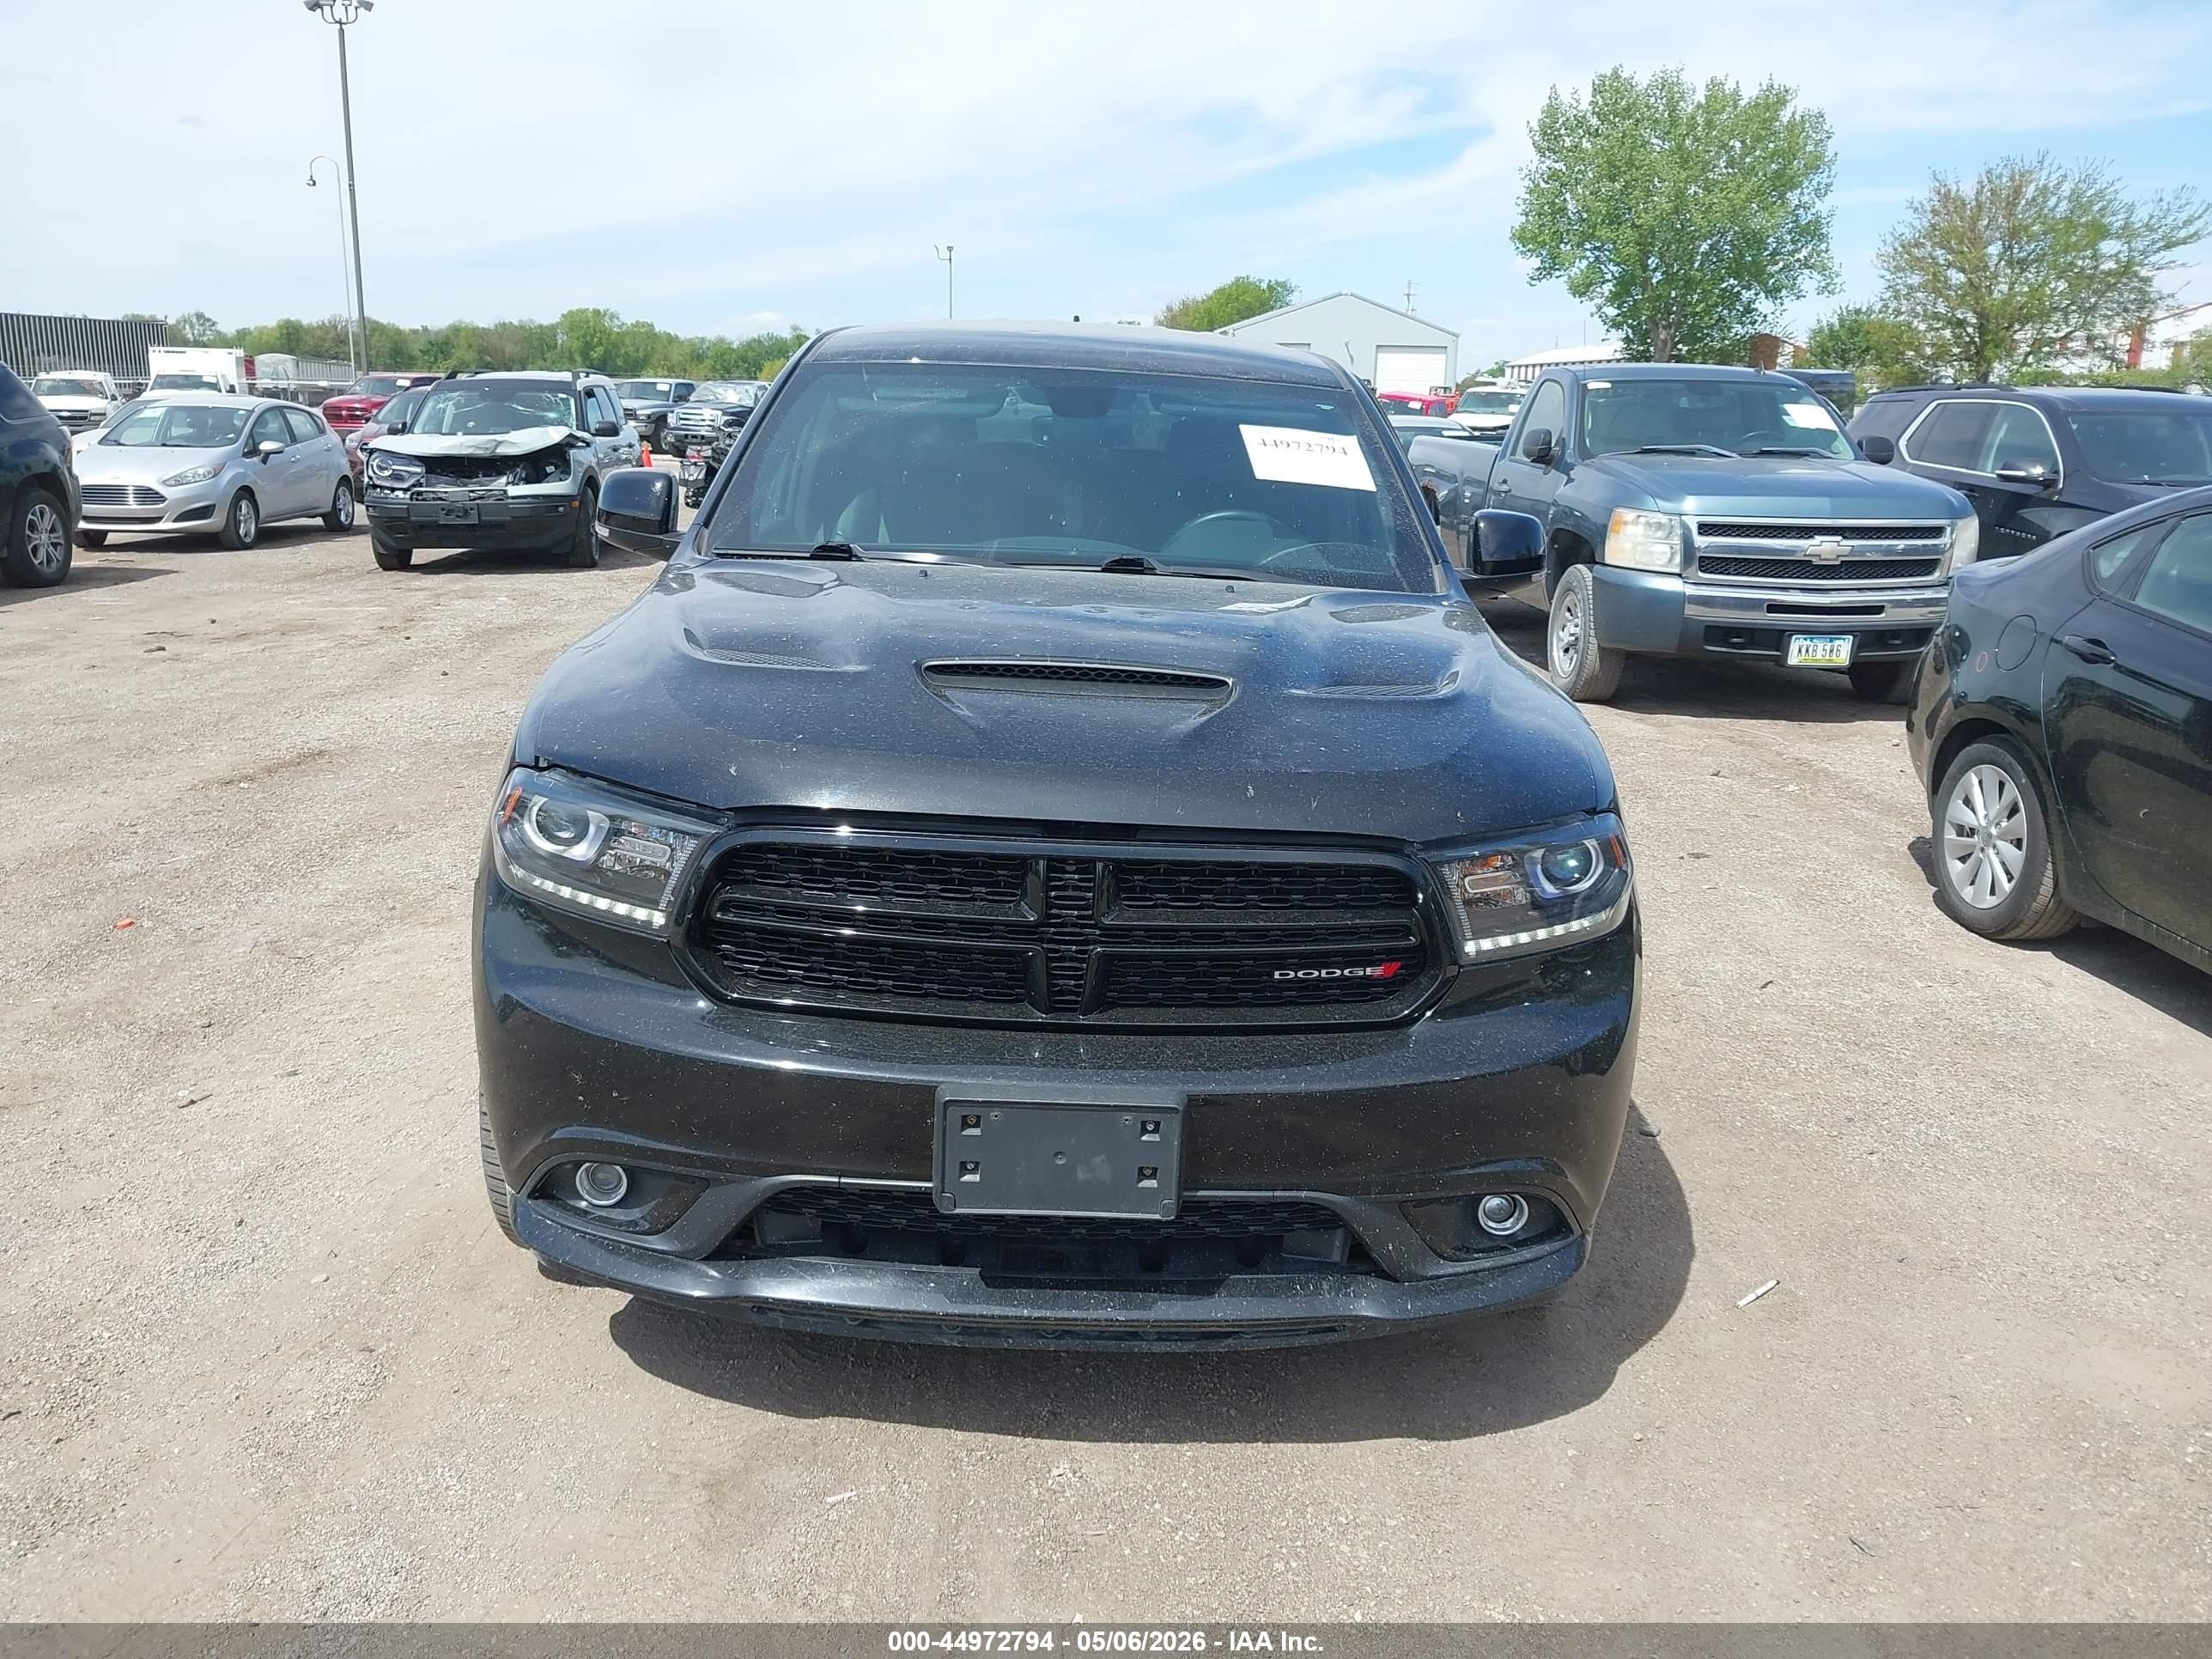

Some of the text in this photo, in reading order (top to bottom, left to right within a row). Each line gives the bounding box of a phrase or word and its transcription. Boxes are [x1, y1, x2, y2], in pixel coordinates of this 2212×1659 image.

[1257, 438, 1347, 456] 44972794
[1797, 644, 1818, 658] KKB
[1273, 966, 1385, 979] DODGE
